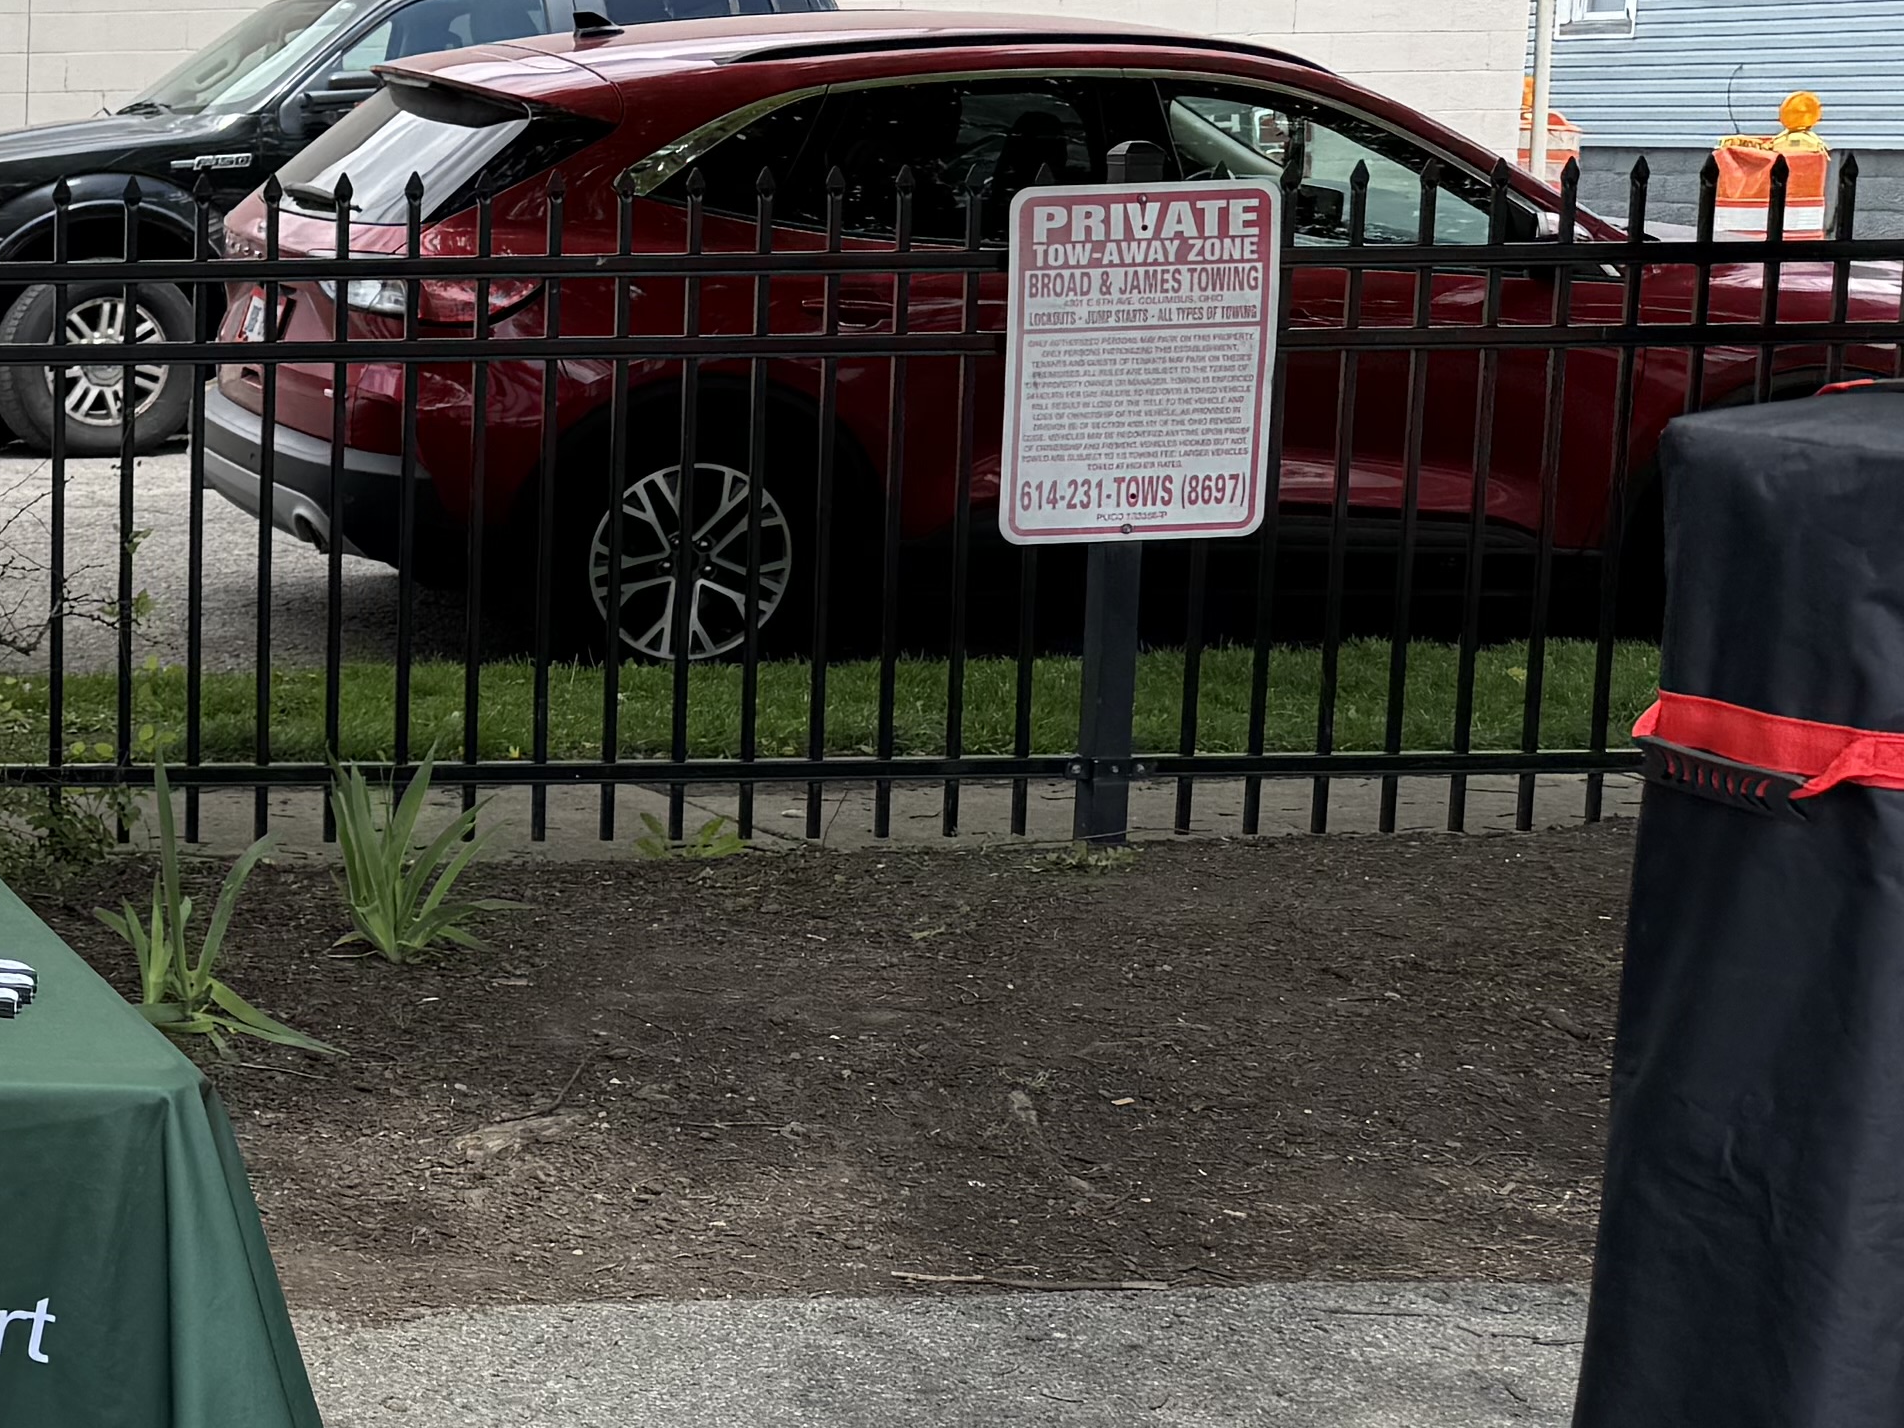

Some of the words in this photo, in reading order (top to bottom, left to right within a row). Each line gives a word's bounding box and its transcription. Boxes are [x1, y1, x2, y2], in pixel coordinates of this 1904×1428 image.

[1032, 198, 1260, 243] PRIVATE
[1032, 239, 1182, 268] TOW-AWAY
[1186, 236, 1259, 261] ZONE
[1028, 272, 1091, 299] BROAD
[1099, 273, 1112, 296] &
[1119, 268, 1183, 296] JAMES
[1186, 265, 1259, 293] TOWING
[1198, 294, 1224, 303] OHIO
[1029, 311, 1076, 327] LOCKOUTS
[1085, 310, 1112, 325] JUMP
[1114, 308, 1149, 324] STARTS
[1157, 307, 1173, 322] ALL
[1176, 306, 1204, 321] TYPES
[1207, 306, 1218, 320] OF
[1221, 304, 1257, 319] TOWING
[1020, 474, 1174, 512] 614-231-TOWS
[1181, 472, 1246, 509] (8697)
